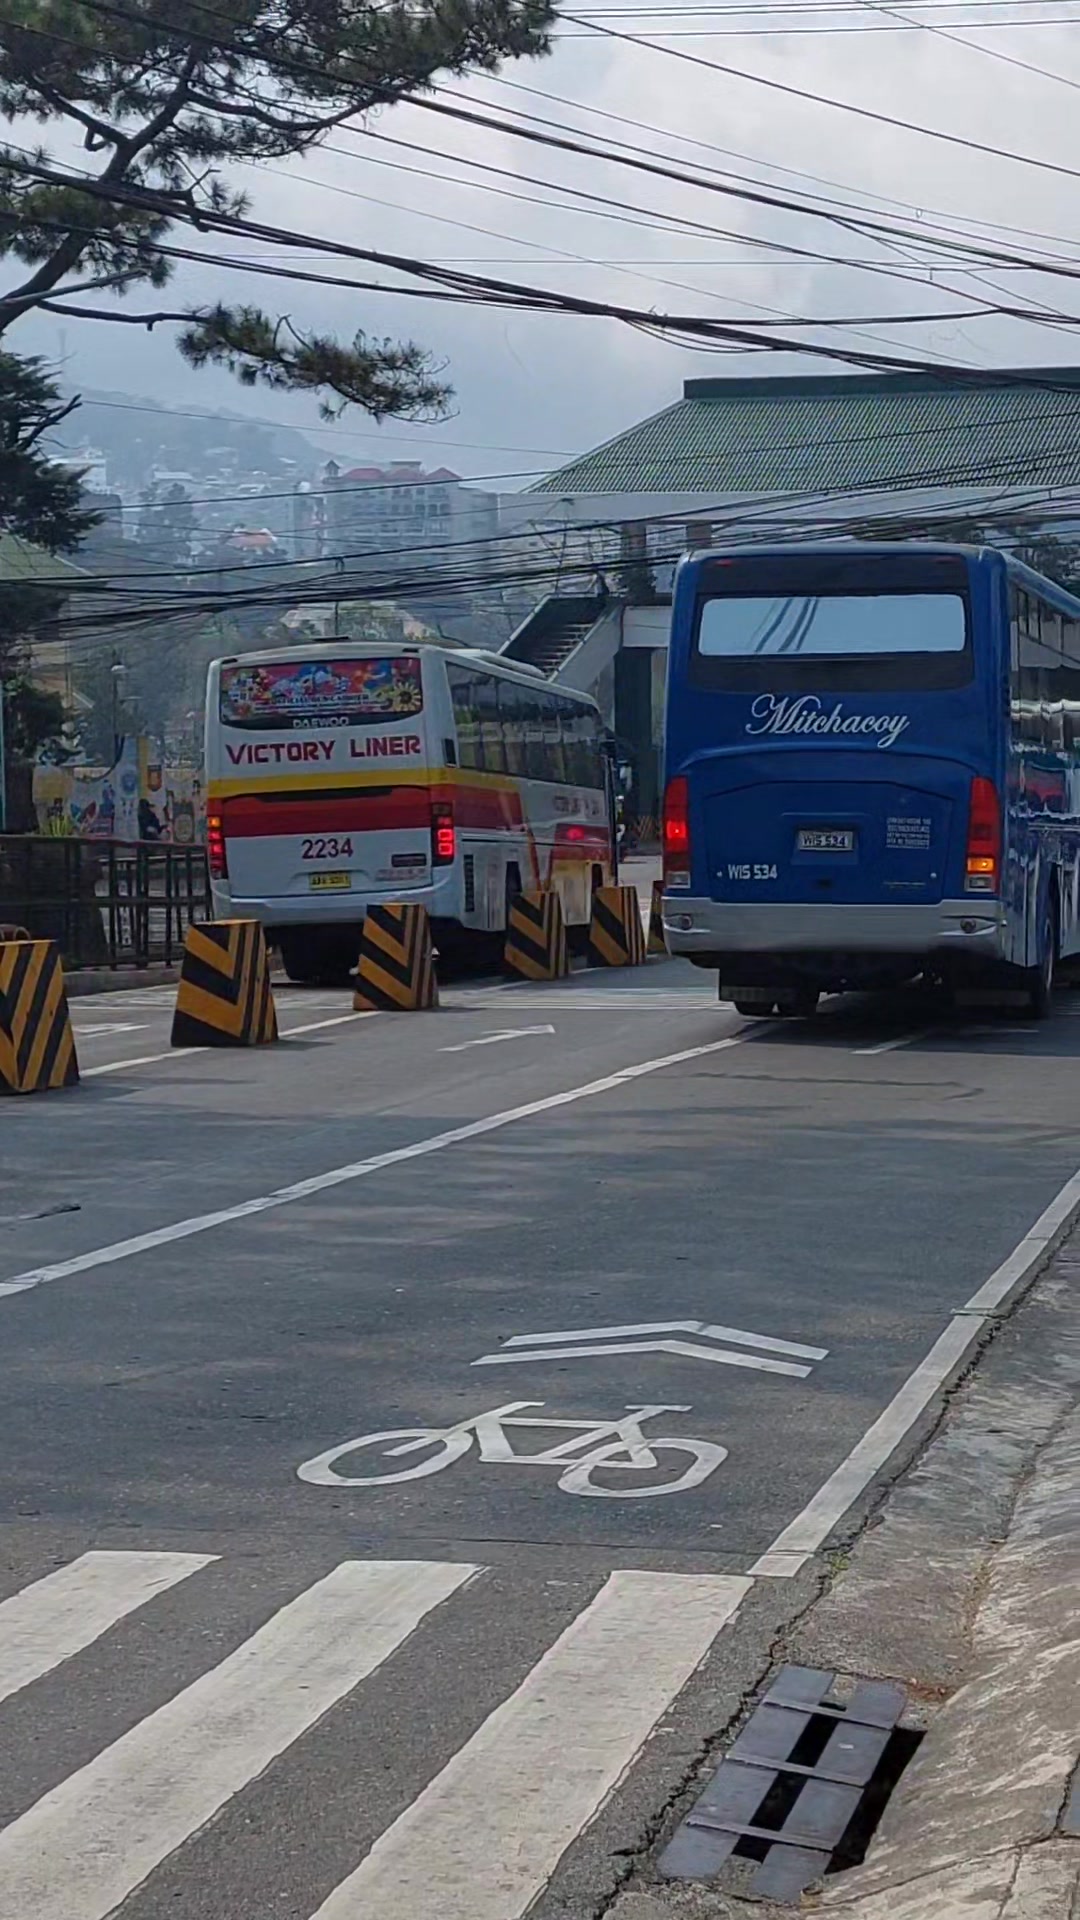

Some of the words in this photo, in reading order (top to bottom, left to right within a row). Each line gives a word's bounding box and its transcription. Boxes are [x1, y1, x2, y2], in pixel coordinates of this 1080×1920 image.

[293, 716, 349, 729] DAEWOO
[745, 693, 910, 748] Mitchacoy
[225, 740, 336, 765] VICTORY
[349, 735, 421, 758] LINER
[301, 838, 354, 859] 2234
[802, 835, 823, 847] WIS
[825, 835, 848, 847] 534
[728, 864, 751, 879] WIS
[753, 864, 777, 879] 534
